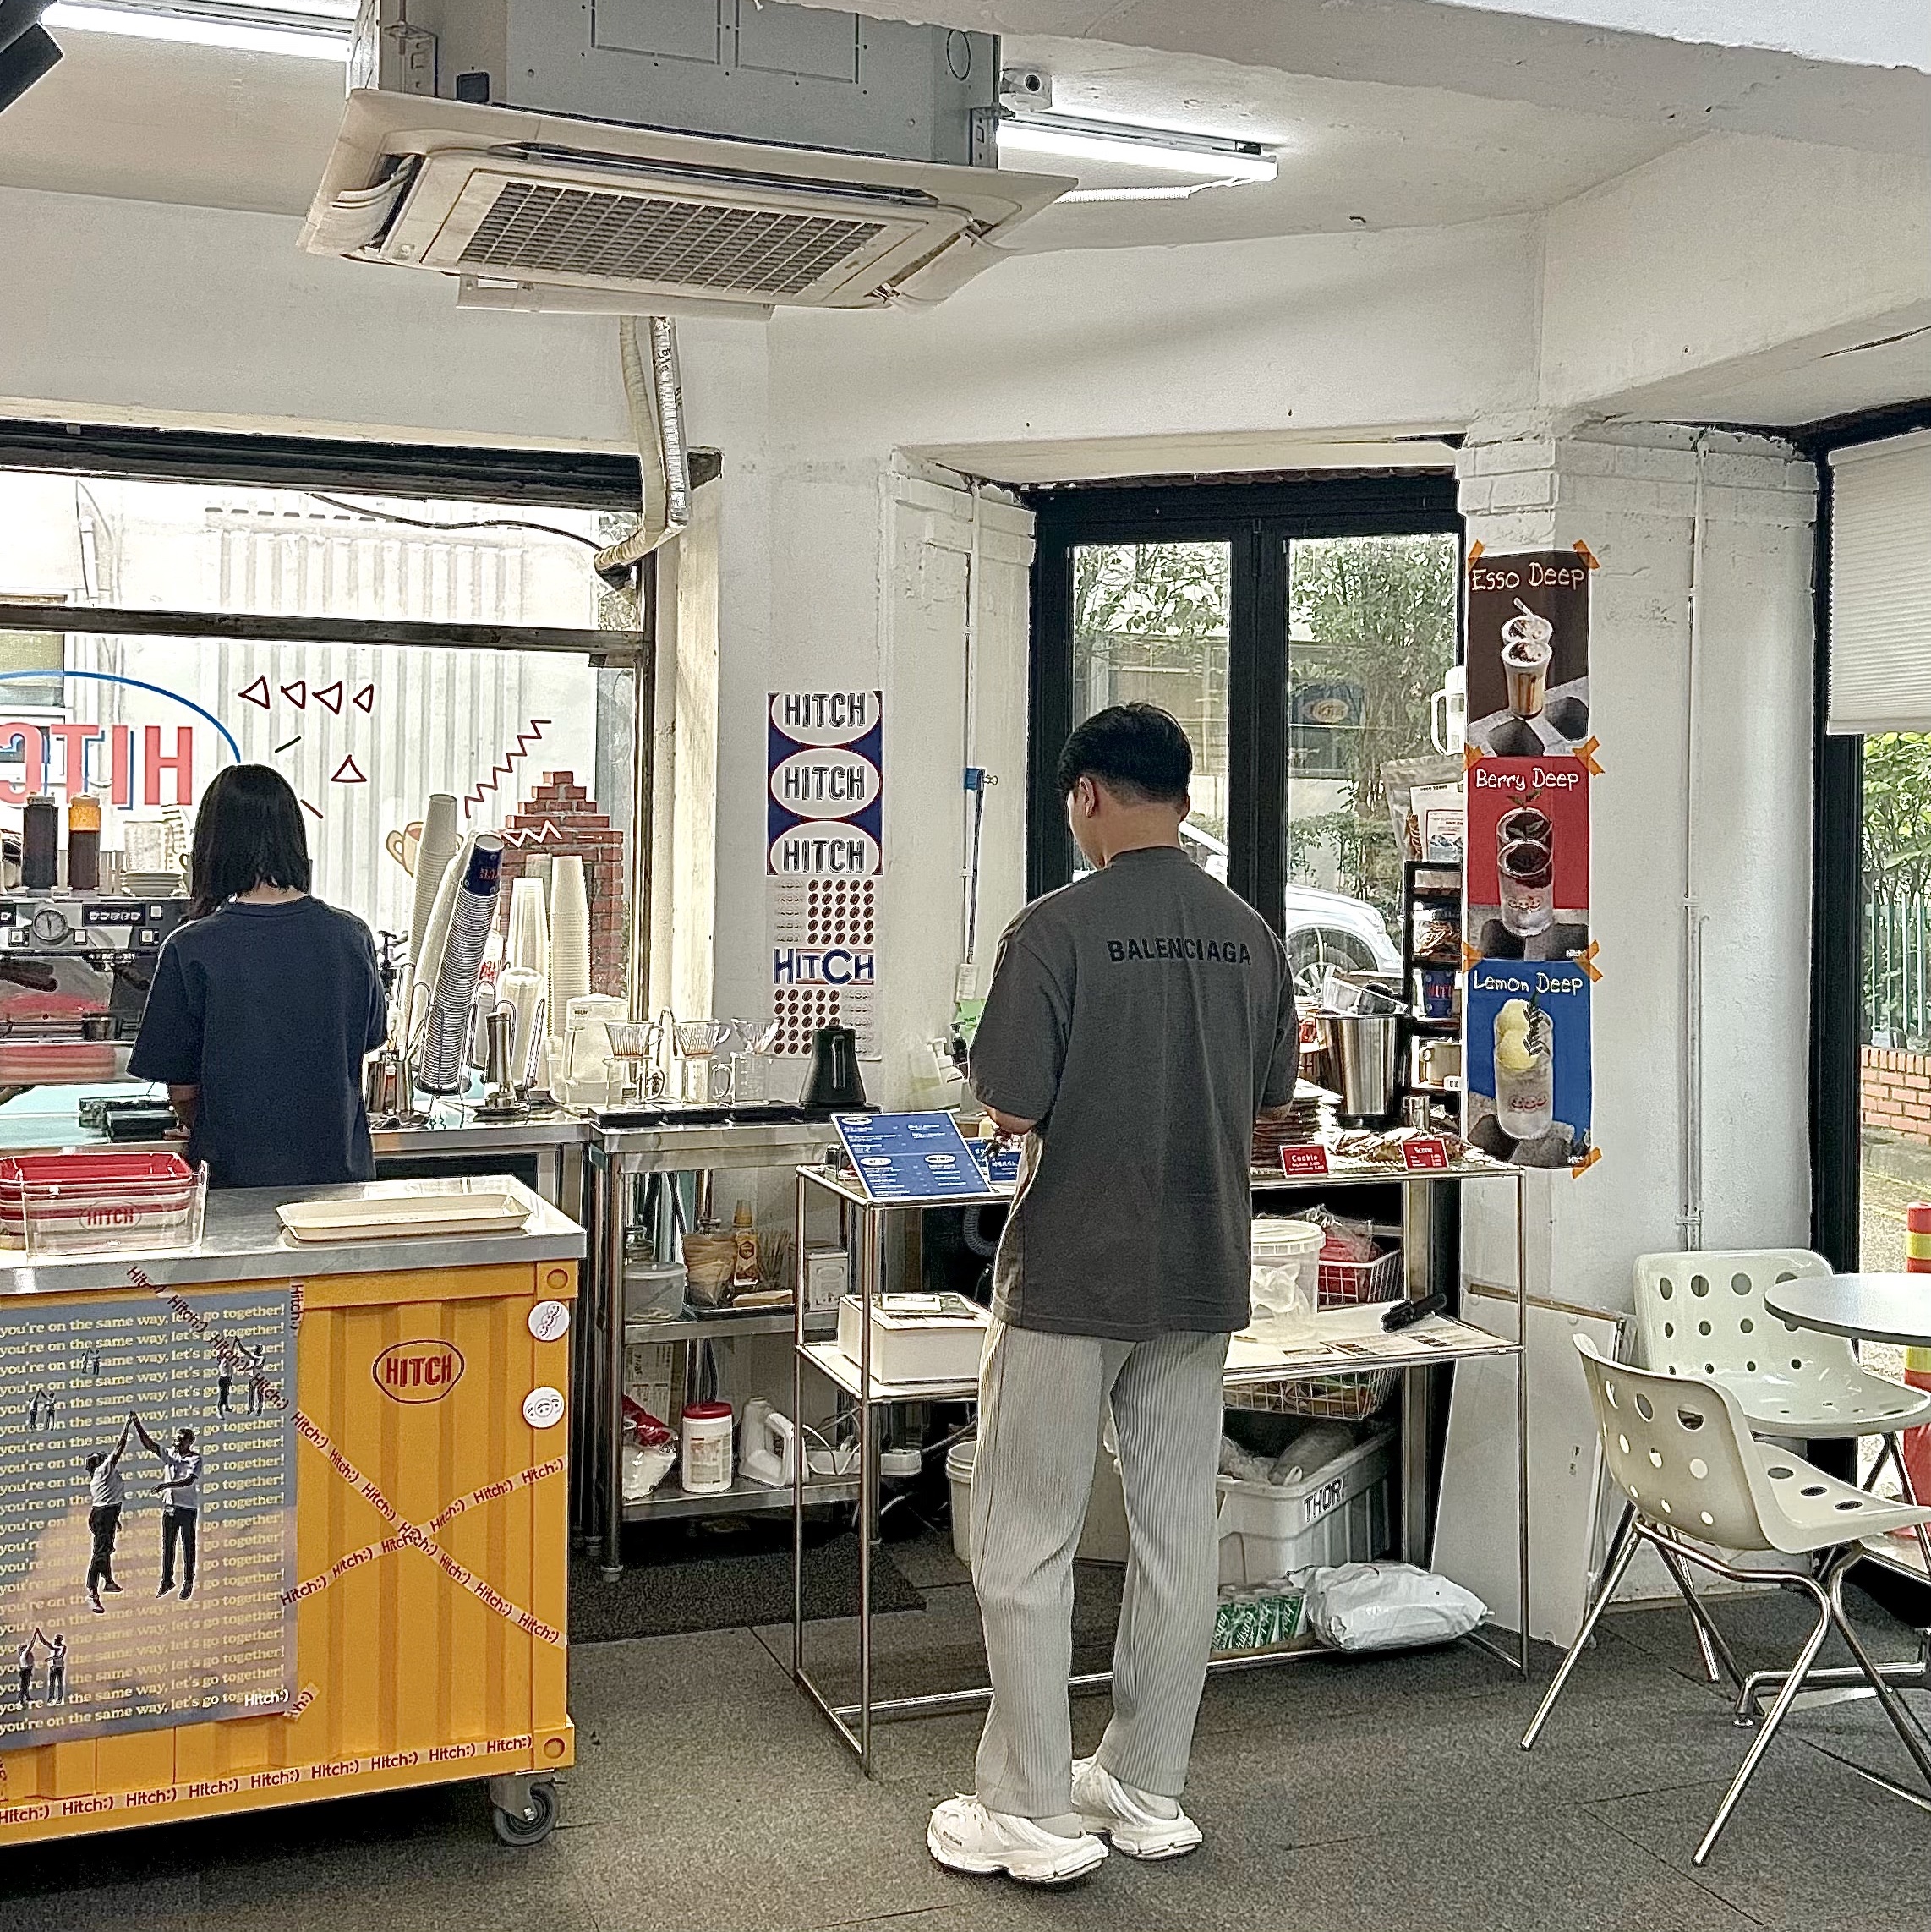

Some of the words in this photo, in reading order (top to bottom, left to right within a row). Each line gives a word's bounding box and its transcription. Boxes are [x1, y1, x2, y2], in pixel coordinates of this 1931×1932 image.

[1472, 568, 1520, 590] Esso
[1529, 561, 1585, 590] Deep
[784, 692, 865, 728] HITCH
[783, 766, 865, 801] HITCH
[1475, 769, 1526, 791] Berry
[1532, 767, 1579, 791] Deep
[783, 839, 865, 873] HITCH
[774, 948, 874, 985] HITCH
[1106, 938, 1251, 965] BALENCIAGA
[1474, 970, 1529, 992] Lemon
[1535, 972, 1584, 995] Deep
[87, 1208, 134, 1226] HITCH
[0, 1322, 44, 1338] you're
[48, 1322, 66, 1333] on
[69, 1319, 93, 1331] the
[96, 1317, 134, 1329] same
[137, 1314, 168, 1327] way,
[203, 1311, 220, 1322] go
[223, 1304, 285, 1321] together!
[290, 1284, 304, 1330] Hitch:)
[0, 1342, 44, 1358] you're
[48, 1342, 66, 1352] on
[69, 1338, 93, 1350] the
[96, 1337, 133, 1349] same
[137, 1333, 168, 1347] way,
[172, 1328, 200, 1342] let's
[223, 1322, 285, 1340] together!
[0, 1361, 44, 1377] you're
[48, 1362, 66, 1371] on
[137, 1353, 168, 1366] way,
[172, 1348, 200, 1361] let's
[48, 1382, 66, 1391] on
[69, 1378, 93, 1389] the
[96, 1376, 133, 1387] same
[137, 1372, 168, 1386] way,
[172, 1367, 200, 1381] let's
[203, 1368, 220, 1381] go
[386, 1354, 452, 1387] HITCH
[69, 1398, 93, 1409] the
[96, 1395, 133, 1407] same
[137, 1392, 168, 1405] way,
[172, 1387, 200, 1400] let's
[69, 1417, 93, 1429] the
[137, 1411, 168, 1425] way,
[172, 1406, 200, 1420] let's
[0, 1441, 44, 1457] you're
[47, 1441, 66, 1450] on
[69, 1437, 92, 1448] the
[203, 1426, 220, 1438] go
[223, 1418, 285, 1435] together!
[0, 1460, 44, 1477] you're
[47, 1460, 65, 1470] on
[203, 1445, 220, 1458] go
[223, 1437, 285, 1454] together!
[0, 1480, 44, 1497] you're
[47, 1480, 65, 1490] on
[203, 1464, 220, 1476] go
[223, 1456, 285, 1474] together!
[0, 1500, 44, 1517] you're
[47, 1500, 65, 1509] on
[203, 1483, 220, 1496] go
[223, 1475, 285, 1492] together!
[1304, 1478, 1343, 1522] THOR
[0, 1519, 44, 1537] you're
[47, 1519, 65, 1530] on
[203, 1502, 220, 1515] go
[223, 1494, 285, 1512] together!
[203, 1522, 220, 1535] go
[223, 1513, 285, 1530] together!
[280, 1576, 327, 1606] Hitch:)
[332, 1547, 374, 1578] Hitch:)
[430, 1500, 466, 1532] Hitch:)
[473, 1480, 514, 1504] Hitch:)
[522, 1459, 565, 1484] Hitch:)
[291, 1411, 329, 1449] Hitch:)
[329, 1448, 359, 1484] Hitch:)
[361, 1483, 396, 1522] Hitch:)
[440, 1553, 471, 1584] Hitch:)
[474, 1583, 513, 1617] Hitch:)
[518, 1612, 560, 1644] Hitch:)
[203, 1541, 220, 1554] go
[223, 1532, 285, 1550] together!
[203, 1560, 220, 1573] go
[223, 1551, 285, 1568] together!
[47, 1598, 65, 1608] on
[203, 1579, 220, 1592] go
[223, 1570, 285, 1588] together!
[47, 1618, 65, 1628] on
[68, 1614, 91, 1626] the
[136, 1606, 168, 1618] way,
[203, 1599, 220, 1612] go
[203, 1618, 220, 1630] go
[223, 1608, 285, 1626] together!
[203, 1637, 220, 1650] go
[223, 1627, 285, 1645] together!
[68, 1672, 91, 1685] the
[95, 1668, 133, 1682] same
[136, 1664, 168, 1677] way,
[171, 1657, 200, 1672] let's
[203, 1656, 220, 1669] go
[223, 1646, 285, 1664] together!
[68, 1693, 91, 1705] the
[95, 1688, 133, 1701] same
[136, 1683, 168, 1696] way,
[171, 1677, 200, 1691] let's
[203, 1676, 220, 1688] go
[223, 1666, 285, 1683] together!
[245, 1689, 289, 1707] Hitch:)
[0, 1717, 43, 1736] you're
[46, 1716, 64, 1727] on
[68, 1712, 91, 1725] the
[95, 1707, 133, 1721] same
[136, 1703, 168, 1716] way,
[171, 1696, 200, 1710] let's
[203, 1694, 220, 1708] go
[0, 1805, 49, 1824] Hitch:)
[63, 1797, 114, 1816] Hitch:)
[126, 1787, 177, 1807] Hitch:)
[189, 1779, 239, 1798] Hitch:)
[251, 1770, 300, 1789] Hitch:)
[311, 1760, 359, 1779] Hitch:)
[371, 1752, 418, 1770] Hitch:)
[429, 1743, 476, 1761] Hitch:)
[486, 1735, 533, 1754] Hitch:)
